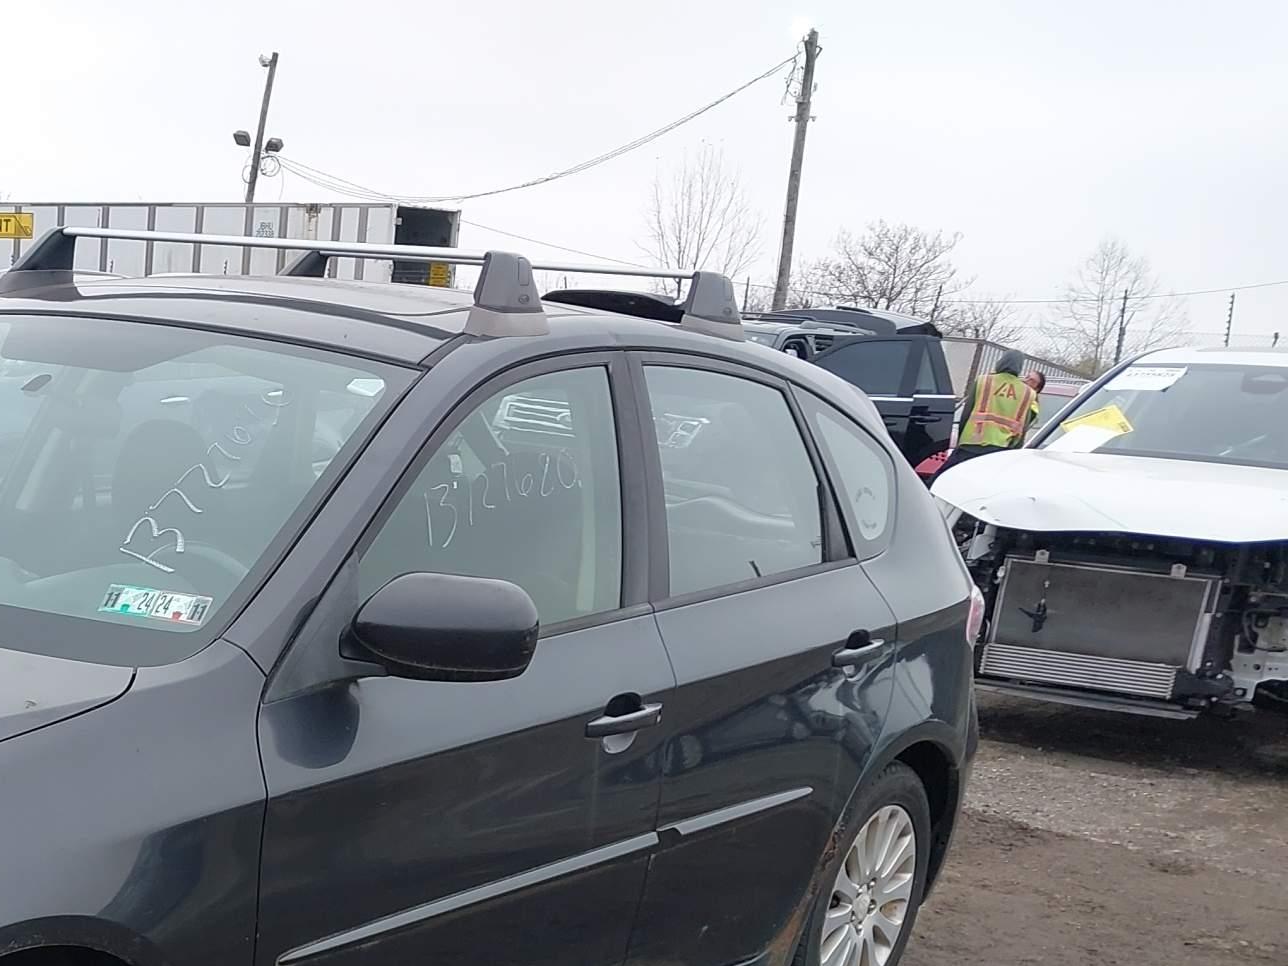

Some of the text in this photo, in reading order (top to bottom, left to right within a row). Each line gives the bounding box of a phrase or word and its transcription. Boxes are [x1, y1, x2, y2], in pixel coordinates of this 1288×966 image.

[104, 591, 155, 611] 11 24
[155, 595, 207, 622] 24 11
